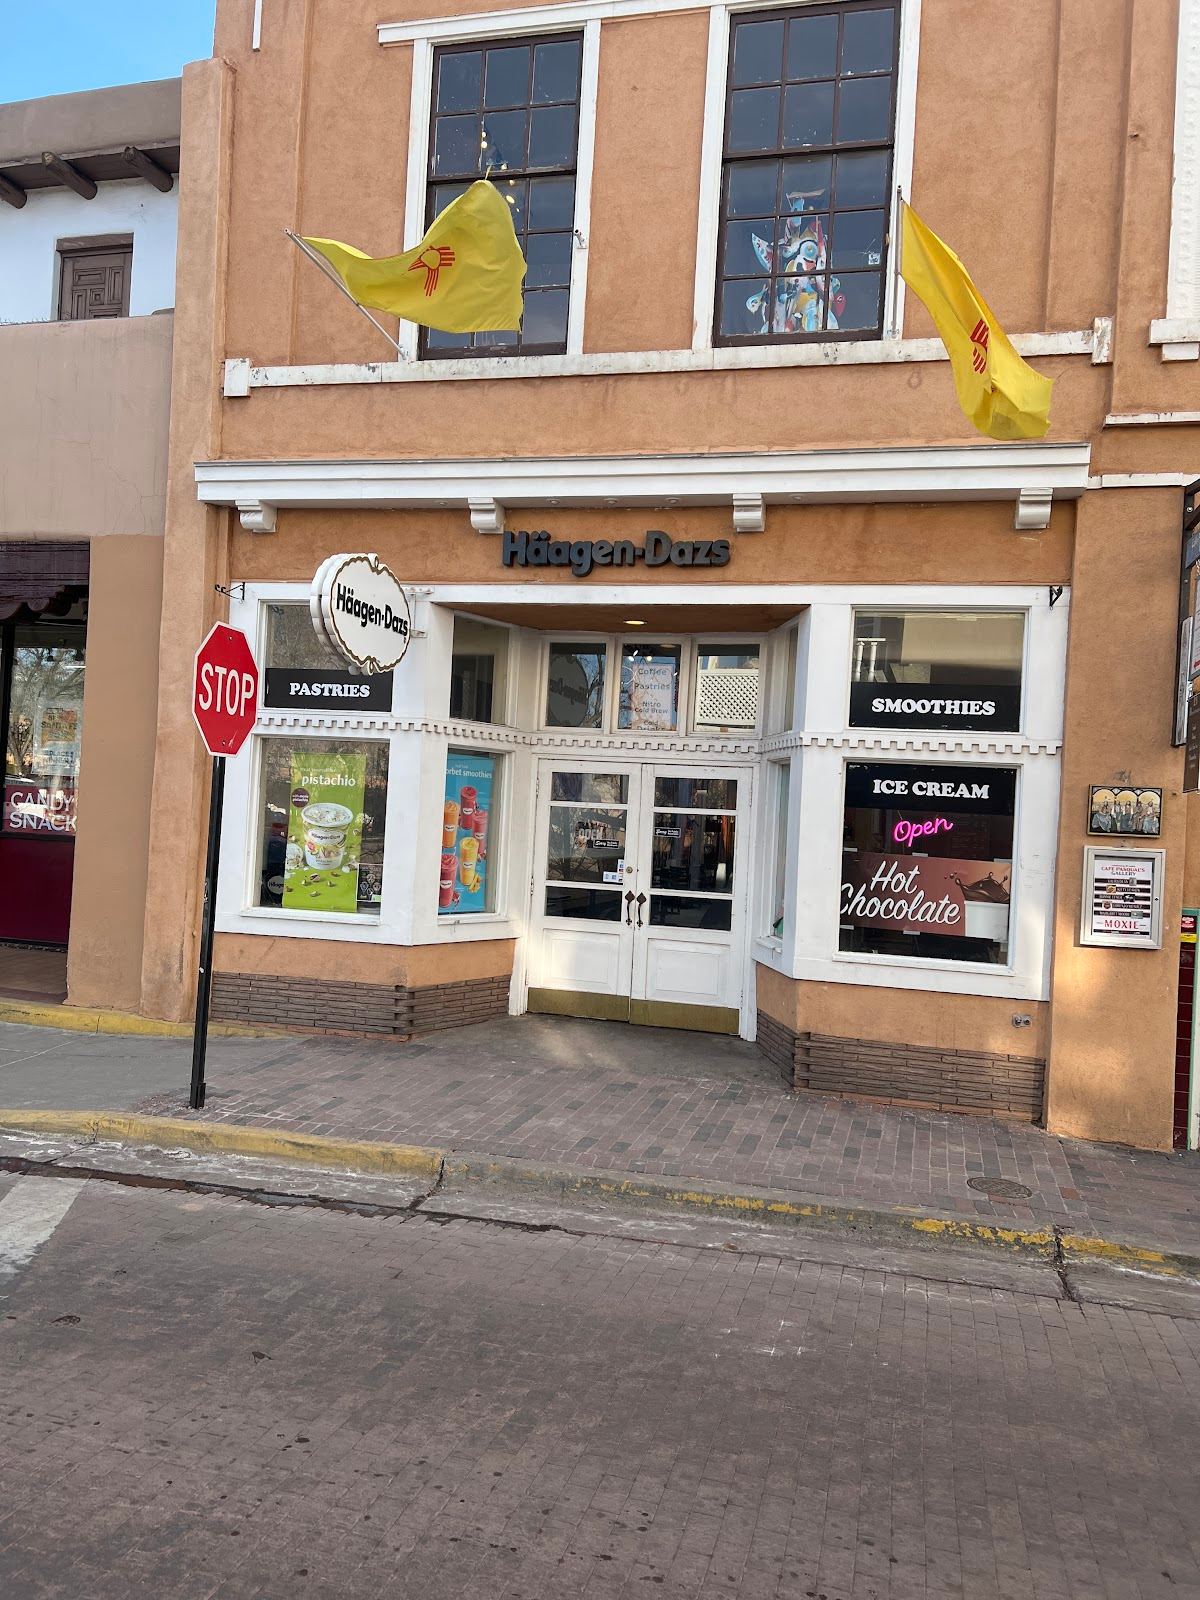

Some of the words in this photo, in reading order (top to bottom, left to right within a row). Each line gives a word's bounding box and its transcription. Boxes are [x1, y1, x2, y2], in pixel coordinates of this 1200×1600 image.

[502, 530, 731, 577] Häagen-Dazs
[198, 662, 254, 717] STOP
[289, 682, 371, 698] PASTRIES
[634, 682, 670, 690] Pastries
[871, 698, 996, 716] SMOOTHIES
[301, 774, 356, 787] pistachio
[462, 770, 492, 779] smoothies
[873, 779, 908, 795] ICE
[912, 781, 990, 799] CREAM
[894, 816, 954, 848] Open
[870, 860, 921, 895] Hot
[840, 883, 961, 925] Chocolate
[1104, 919, 1139, 930] MOXIE
